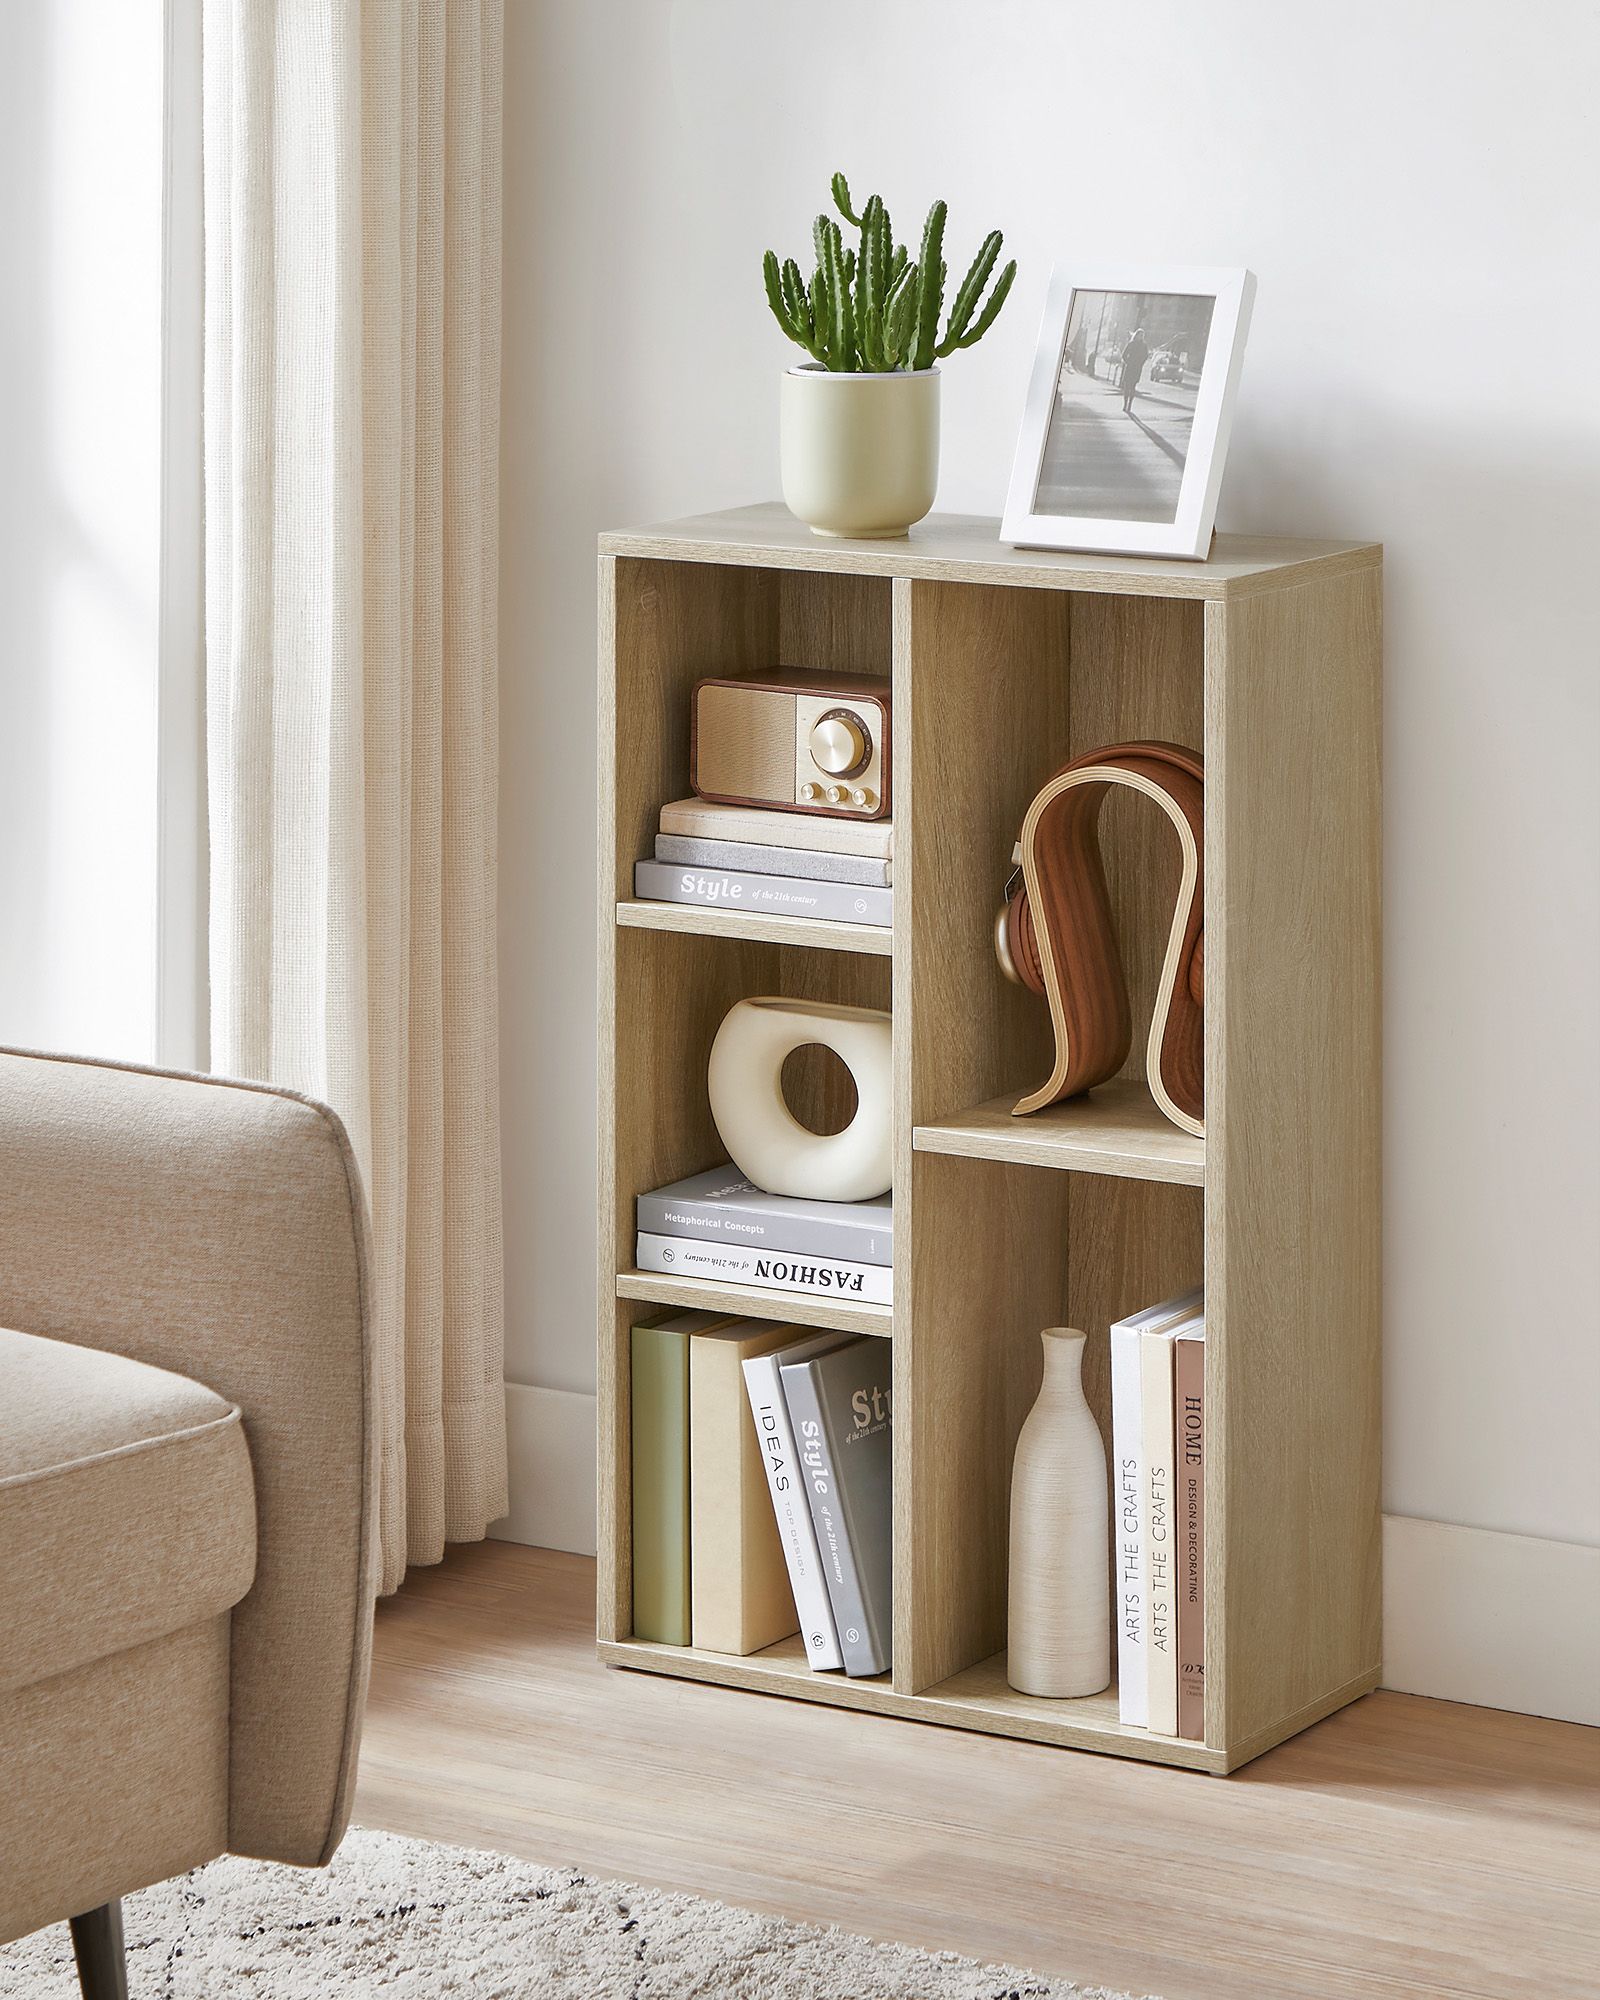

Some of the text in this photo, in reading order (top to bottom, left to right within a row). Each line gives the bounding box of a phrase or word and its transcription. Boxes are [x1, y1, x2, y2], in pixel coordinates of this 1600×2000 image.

[680, 874, 743, 901] Style
[752, 889, 762, 900] of
[762, 890, 774, 900] the
[790, 895, 818, 906] century
[664, 1212, 765, 1235] Metaphorical Concepts
[683, 1252, 711, 1263] century
[728, 1260, 740, 1270] the
[740, 1261, 750, 1271] of
[754, 1259, 865, 1292] FASHION
[801, 1420, 830, 1495] Style
[760, 1406, 806, 1577] IDEAS TOP DESIGN
[1185, 1396, 1202, 1603] HOME DESIGN & DECORATING
[821, 1506, 832, 1517] of
[825, 1518, 833, 1532] the
[1122, 1459, 1140, 1644] ARTS THE CRAFTS
[1151, 1467, 1168, 1653] ARTS THE CRAFTS
[832, 1552, 844, 1584] century
